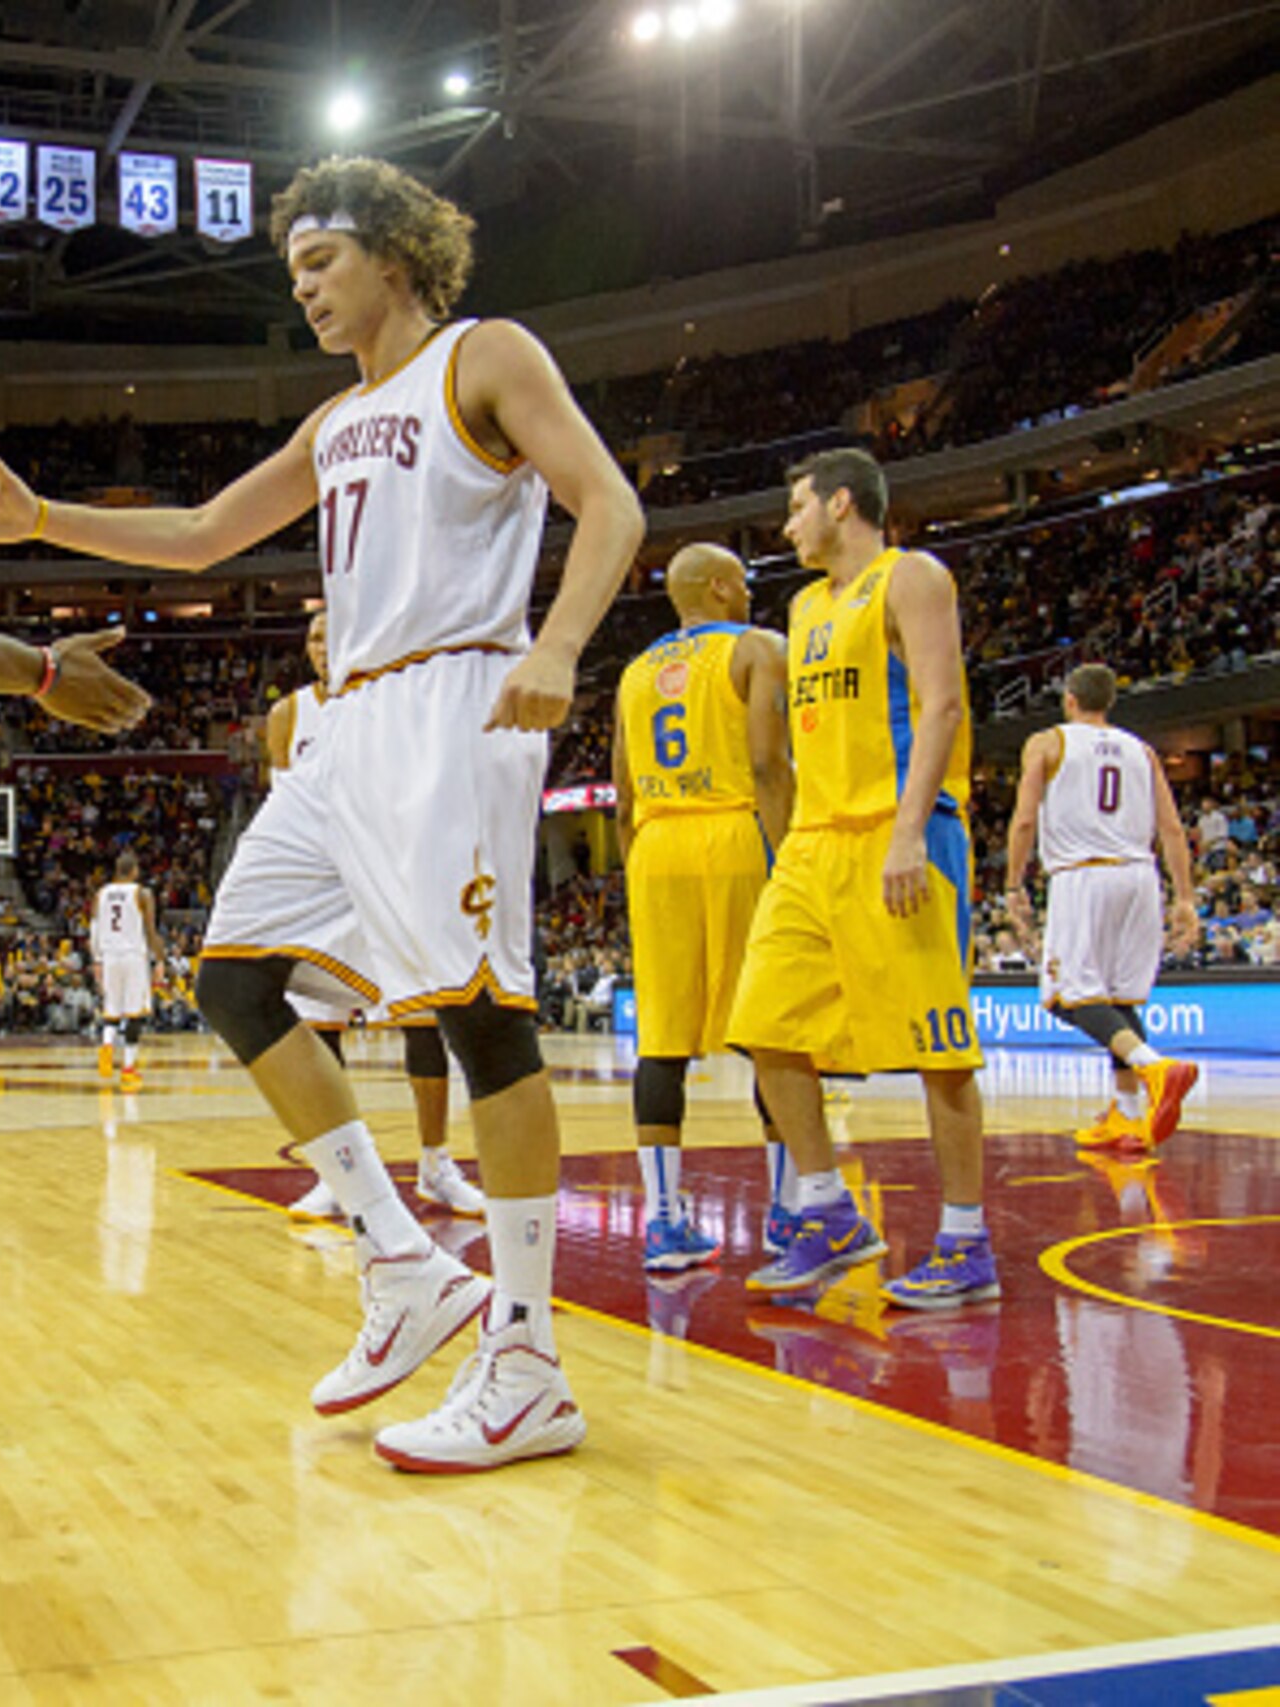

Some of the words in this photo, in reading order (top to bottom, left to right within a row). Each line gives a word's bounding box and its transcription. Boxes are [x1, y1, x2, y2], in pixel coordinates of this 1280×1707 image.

[44, 176, 89, 216] 25
[125, 182, 169, 221] 43
[207, 189, 242, 225] 11
[324, 477, 369, 575] 17
[651, 702, 690, 769] 6
[1098, 765, 1121, 815] 0
[111, 903, 122, 933] 2
[926, 1006, 971, 1053] 10
